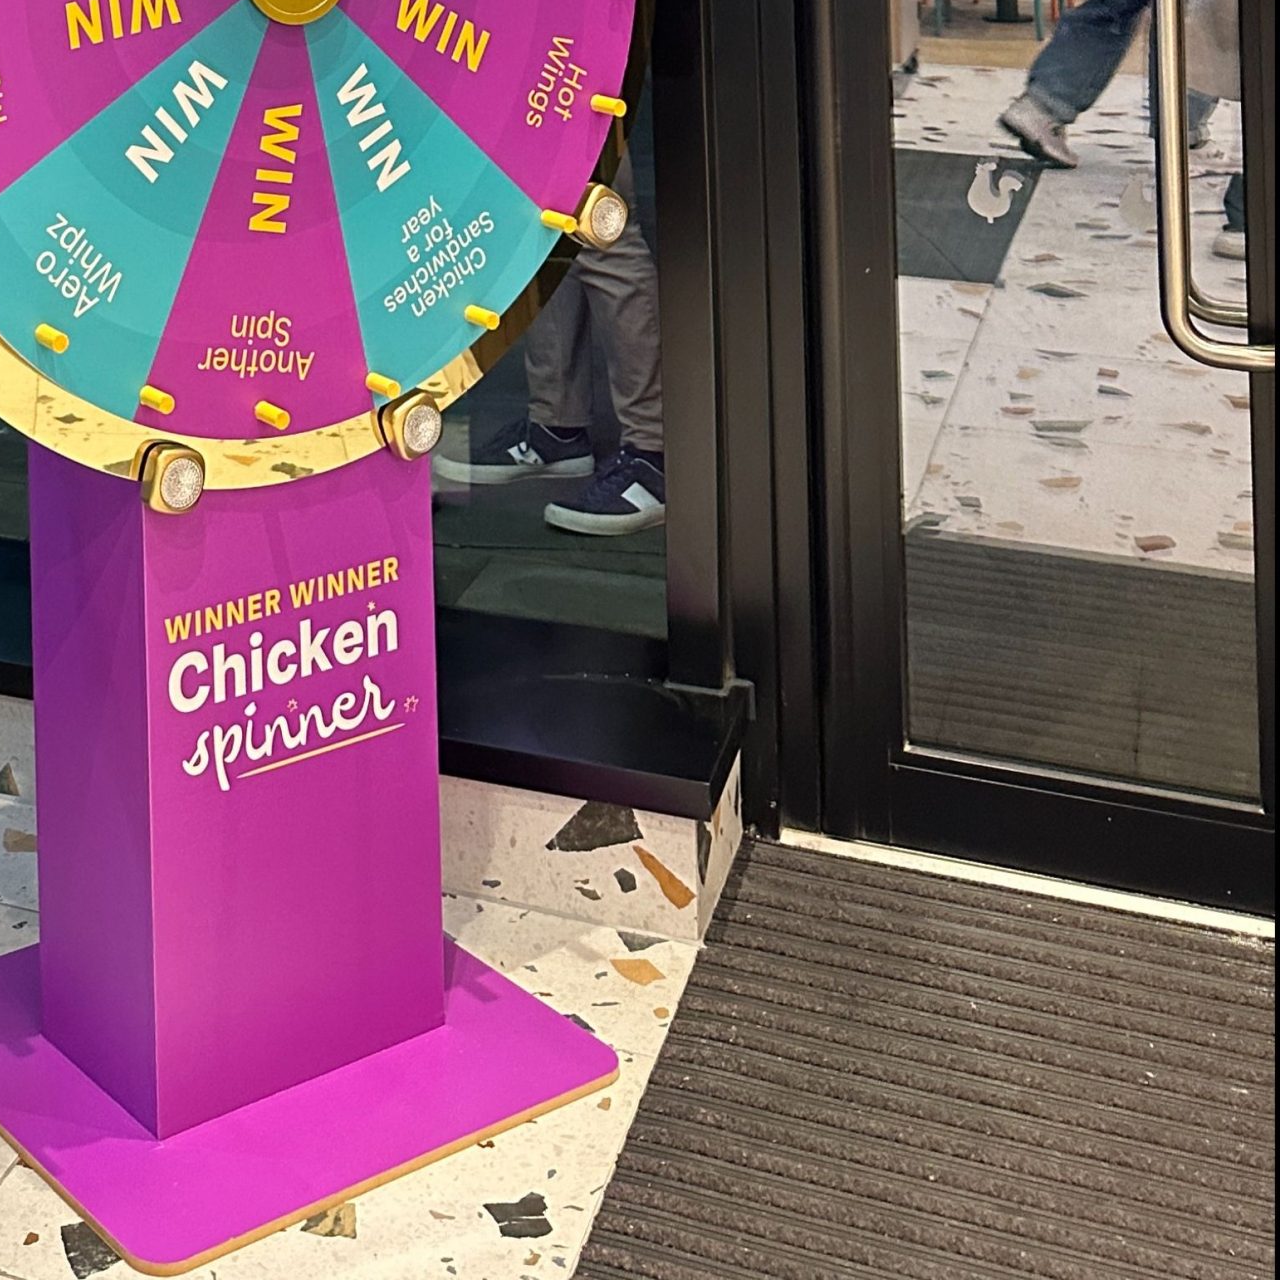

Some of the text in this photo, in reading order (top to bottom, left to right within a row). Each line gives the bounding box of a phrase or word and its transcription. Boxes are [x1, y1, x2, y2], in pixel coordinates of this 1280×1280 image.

[124, 59, 229, 184] WIN
[526, 35, 575, 129] Wings
[554, 62, 588, 121] Hot
[248, 103, 304, 234] WIN
[336, 62, 411, 193] WIN
[45, 212, 123, 303] Whipz
[383, 210, 496, 313] Sandwiches
[400, 195, 444, 244] year
[407, 217, 454, 265] for a
[35, 250, 100, 319] Aero
[411, 245, 488, 318] Chicken
[197, 346, 315, 381] Another
[230, 310, 293, 347] Spin
[164, 556, 400, 644] WINNER WINNER
[168, 609, 399, 713] Chicken
[182, 674, 396, 792] spinner
